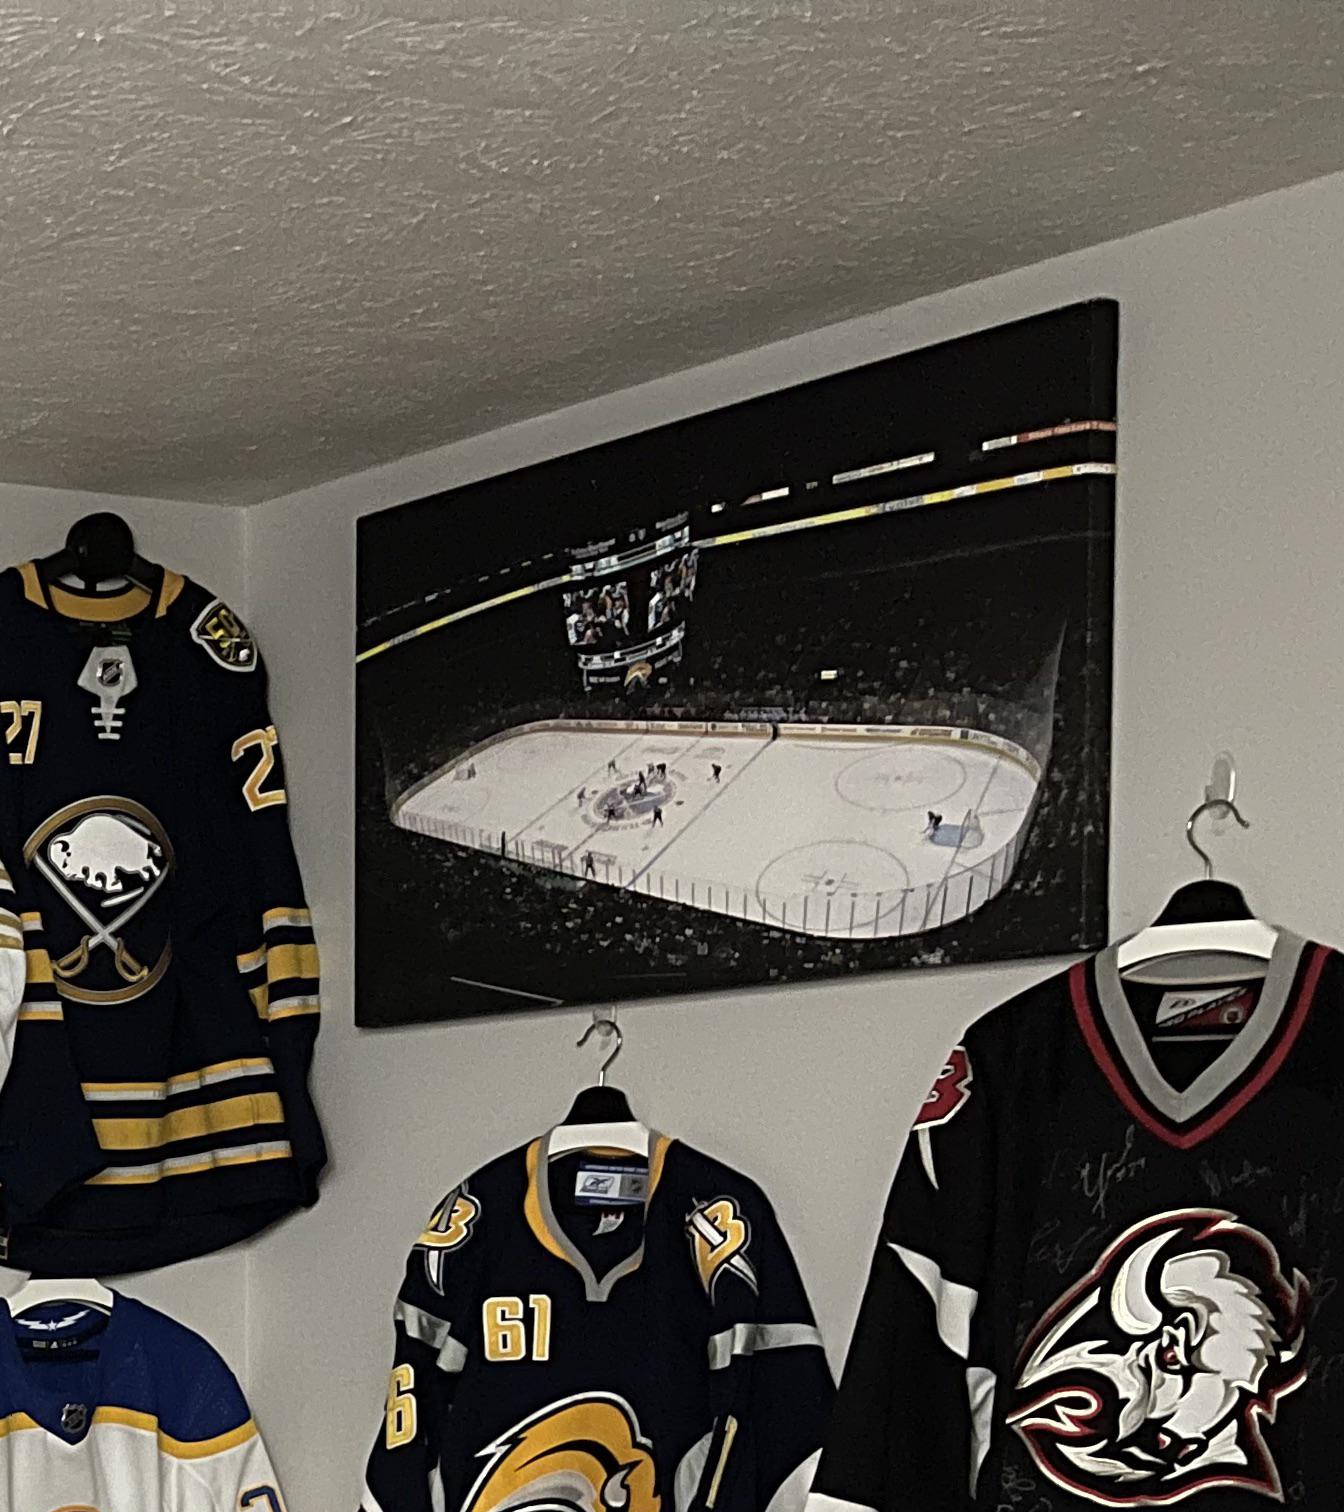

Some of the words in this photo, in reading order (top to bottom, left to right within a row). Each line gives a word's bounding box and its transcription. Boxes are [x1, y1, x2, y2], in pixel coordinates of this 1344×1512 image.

[231, 725, 288, 812] 2
[482, 1294, 551, 1362] 61
[385, 1364, 417, 1450] 6
